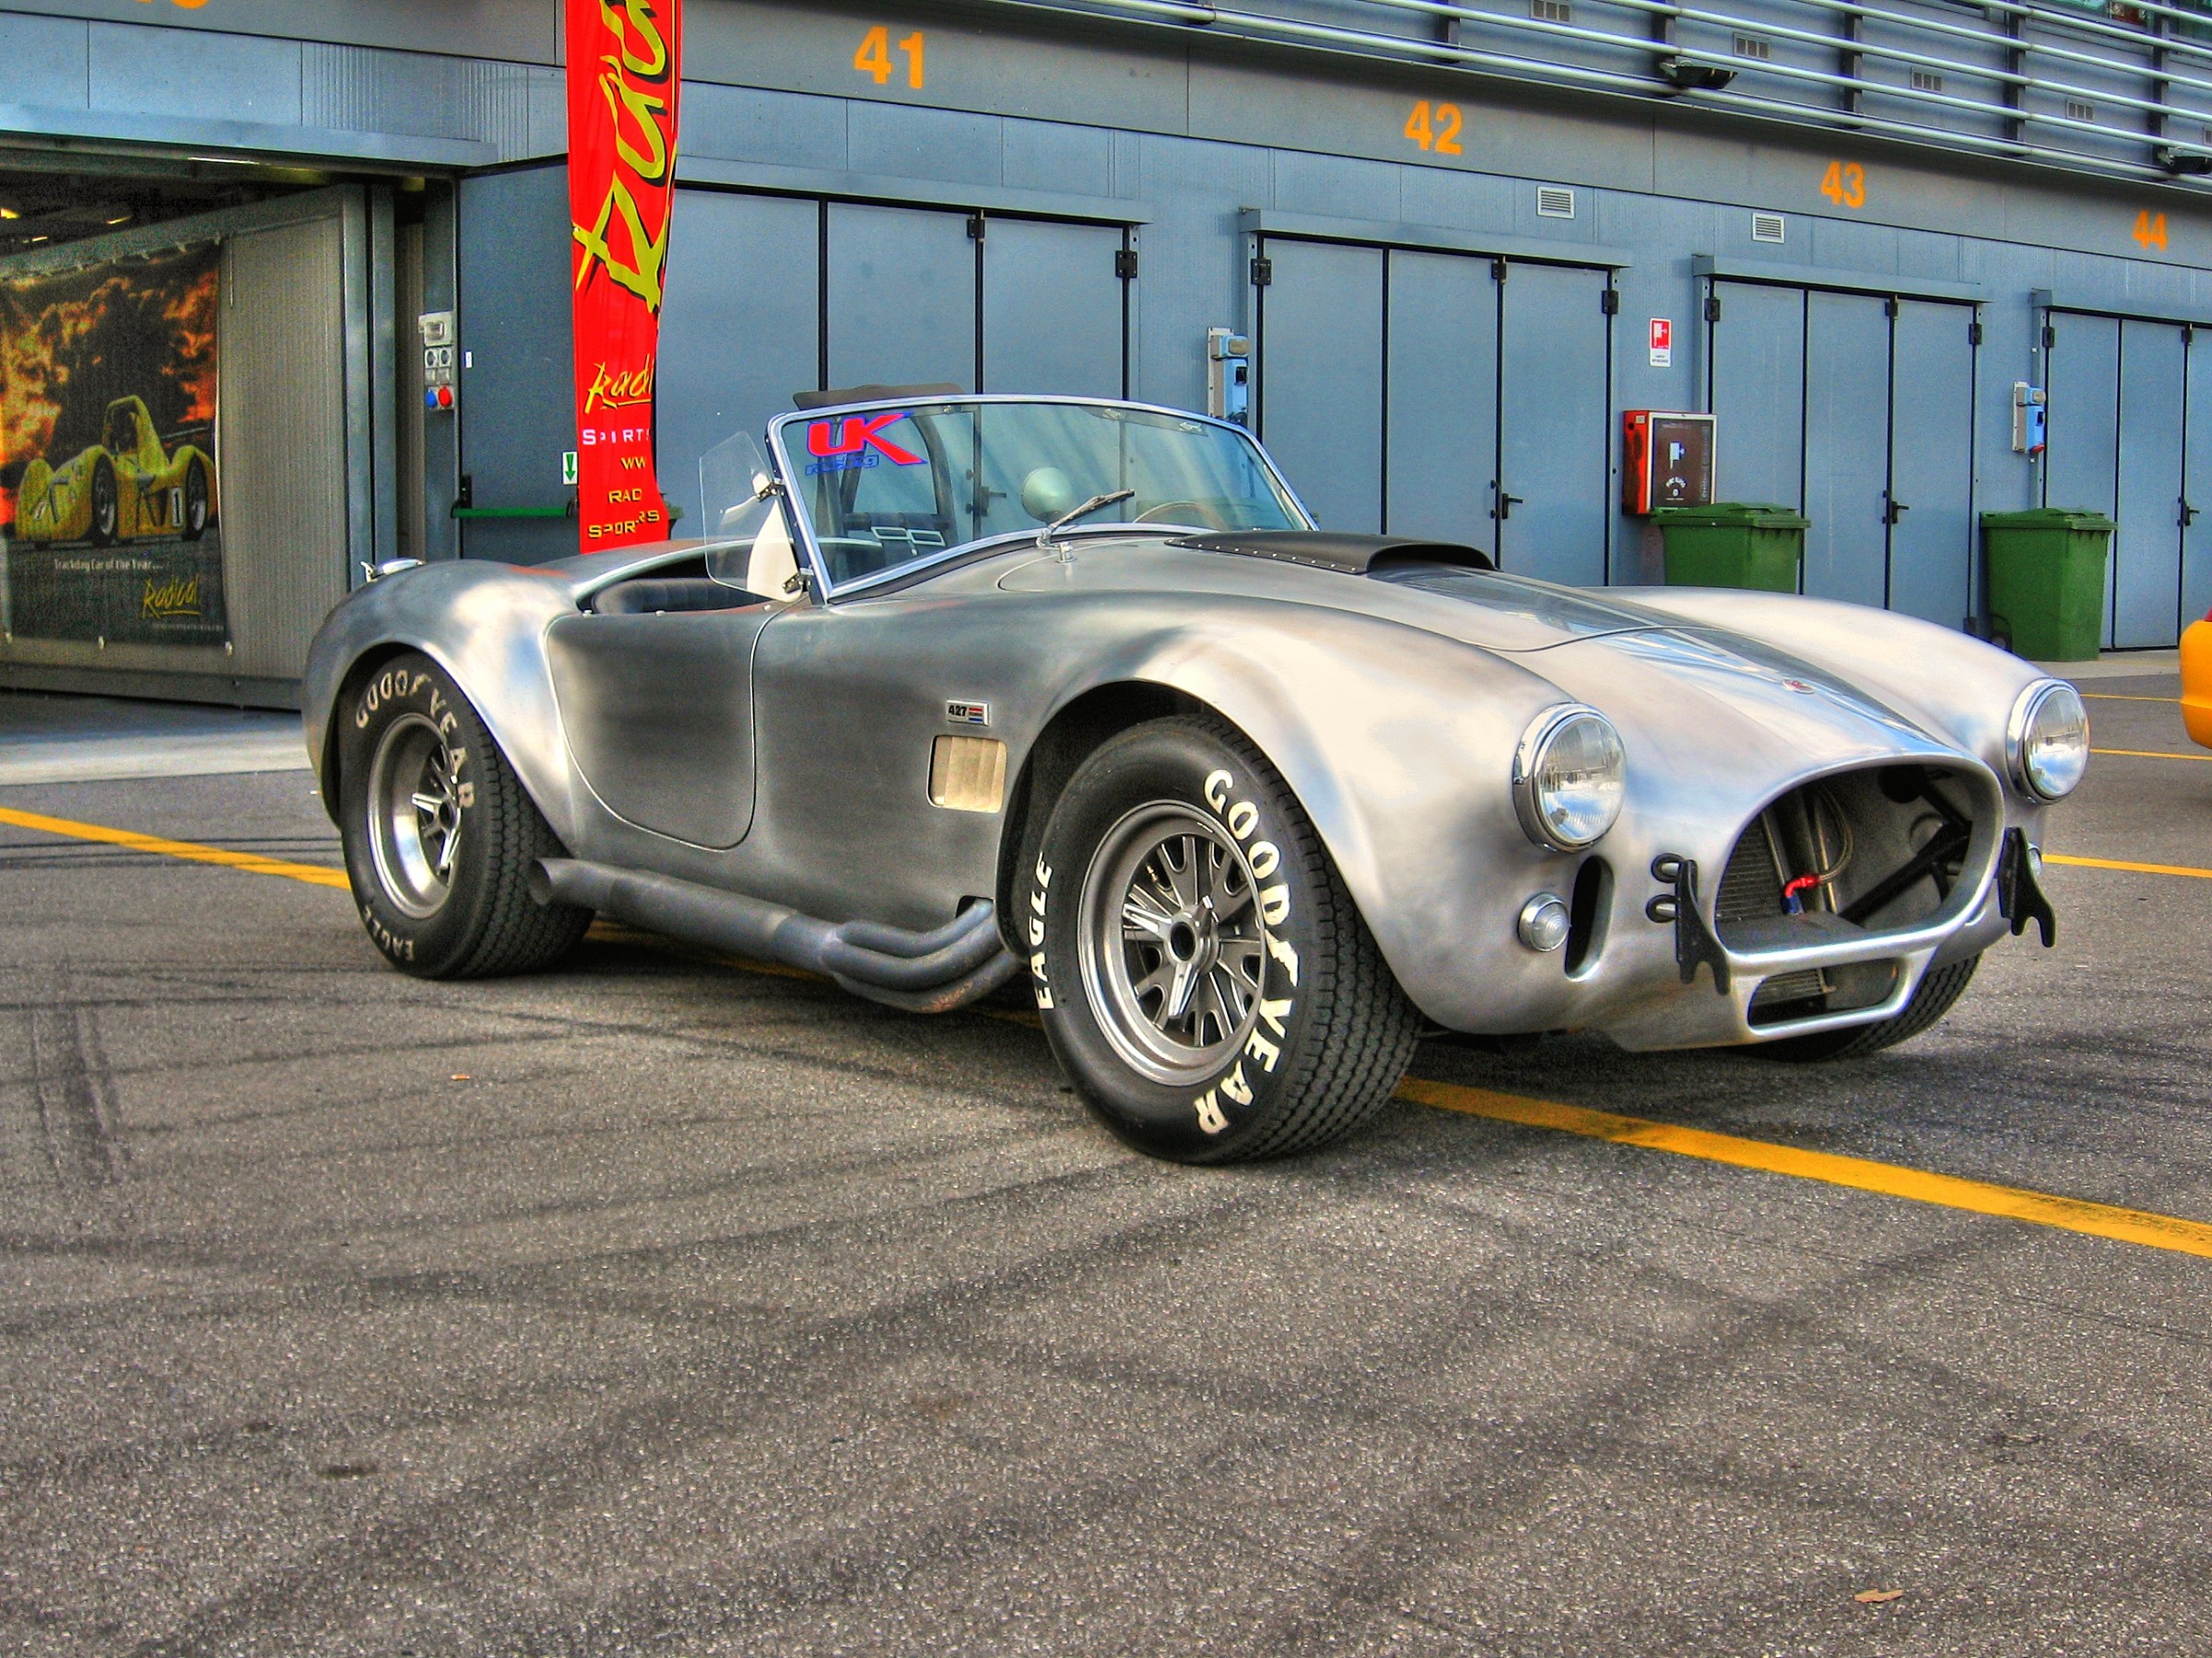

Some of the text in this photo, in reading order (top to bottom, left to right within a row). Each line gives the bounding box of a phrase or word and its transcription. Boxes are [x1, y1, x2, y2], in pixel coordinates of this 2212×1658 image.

[853, 25, 924, 89] 41
[1405, 99, 1464, 156] 42
[1820, 160, 1866, 208] 43
[2132, 209, 2168, 252] 44
[807, 411, 928, 466] UK
[142, 572, 201, 620] Radical
[948, 705, 968, 717] 427
[1029, 852, 1054, 1010] EAGLE
